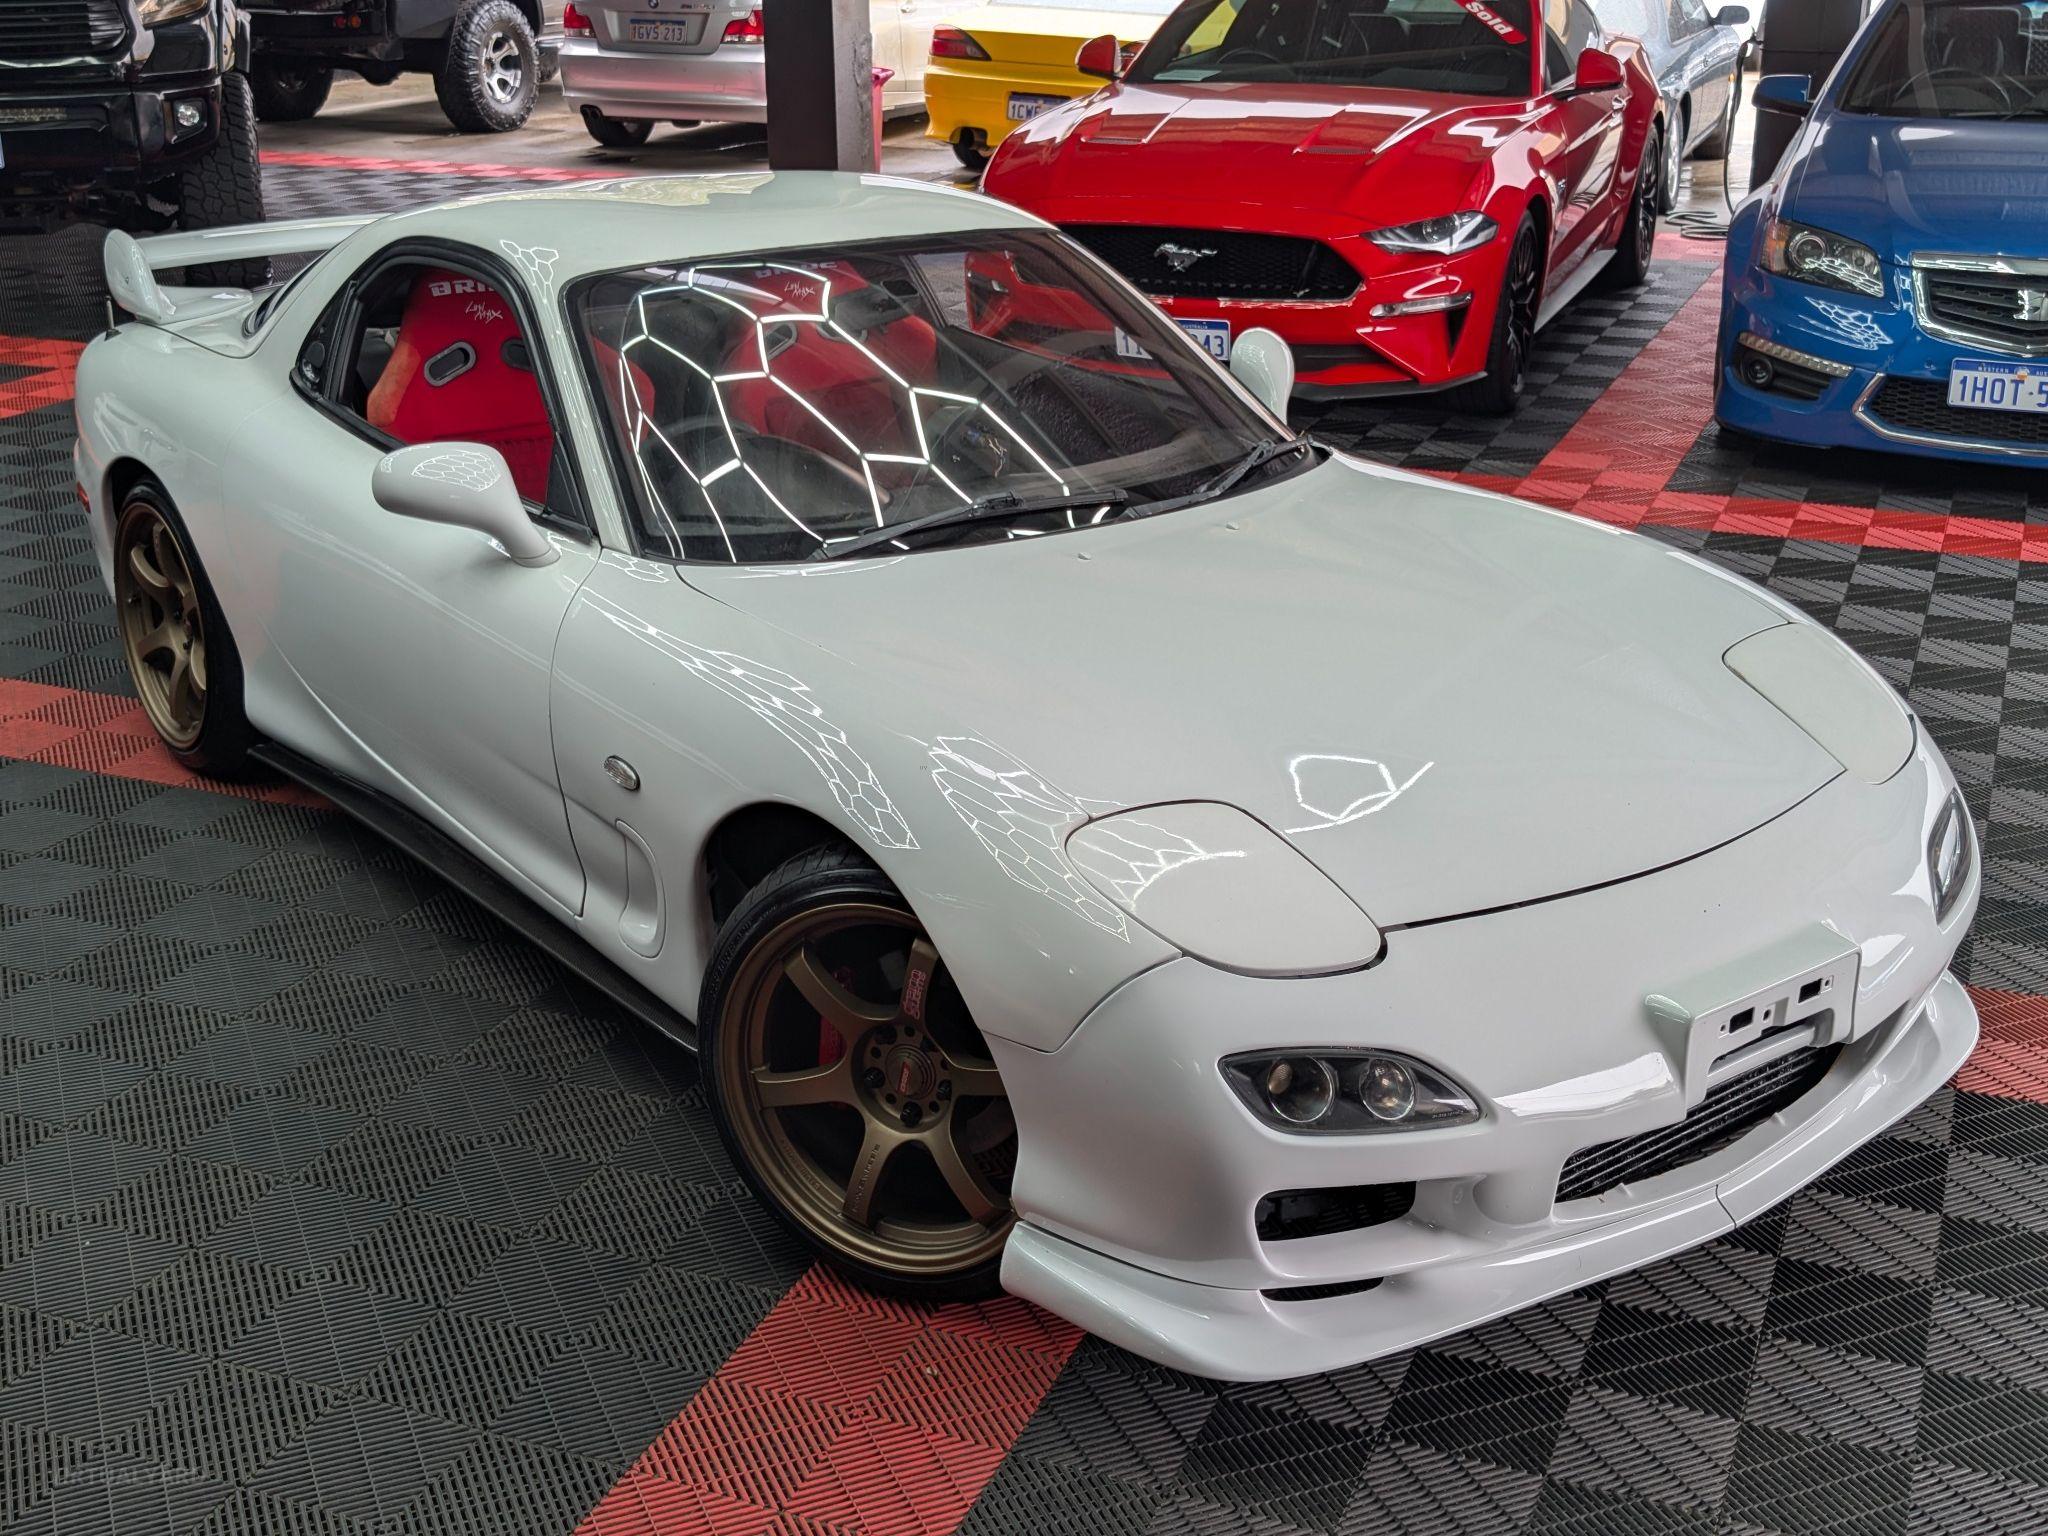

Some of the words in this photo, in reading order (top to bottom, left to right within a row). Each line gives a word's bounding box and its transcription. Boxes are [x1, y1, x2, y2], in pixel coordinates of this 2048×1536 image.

[1465, 2, 1514, 34] Sold
[664, 27, 683, 41] 213
[428, 279, 495, 297] BRI
[1960, 375, 2025, 406] 1HOT
